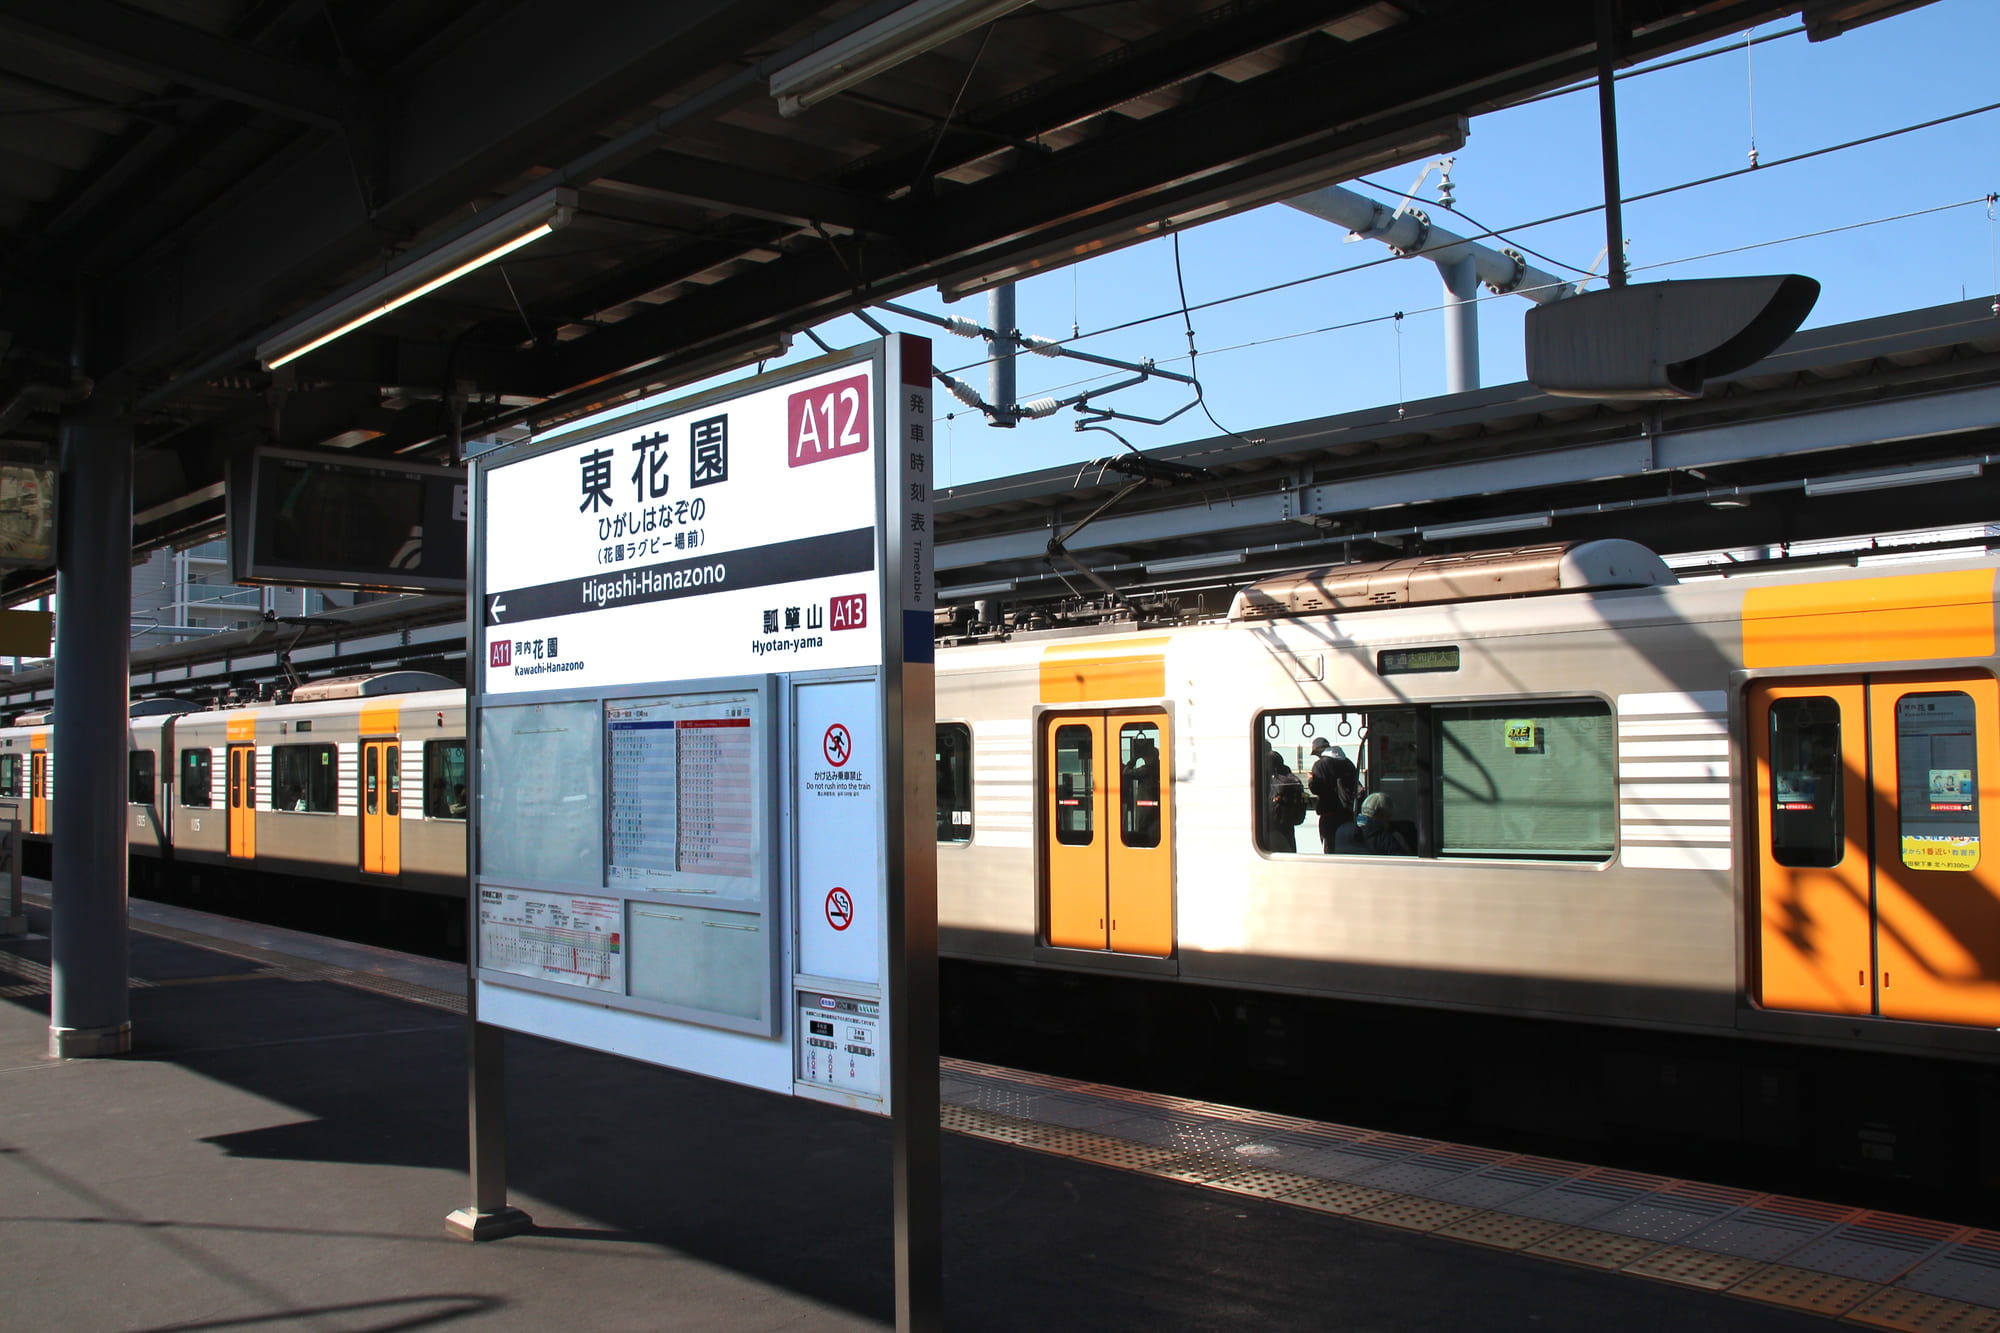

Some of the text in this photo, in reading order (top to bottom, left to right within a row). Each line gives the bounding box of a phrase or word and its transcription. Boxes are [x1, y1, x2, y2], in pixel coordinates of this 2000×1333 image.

[796, 387, 861, 458] A12
[579, 412, 728, 514] 東花園
[909, 393, 925, 532] 発車時刻表
[598, 497, 706, 541] ひがしはなぞの
[597, 528, 705, 564] (花園ラグビー場前)
[582, 563, 726, 607] Higashi-Hanazono
[912, 540, 922, 603] Timetable
[834, 597, 863, 629] A13
[492, 643, 509, 665] A11
[515, 637, 558, 660] 河内花園
[752, 636, 823, 656] Hyotan-yama
[514, 661, 584, 676] Kawachi-Hanazono
[806, 782, 814, 790] Do
[825, 782, 836, 790] rush
[837, 782, 847, 790] into
[849, 782, 857, 790] the
[858, 782, 871, 790] train
[814, 771, 862, 781] かけ込み乗車禁止
